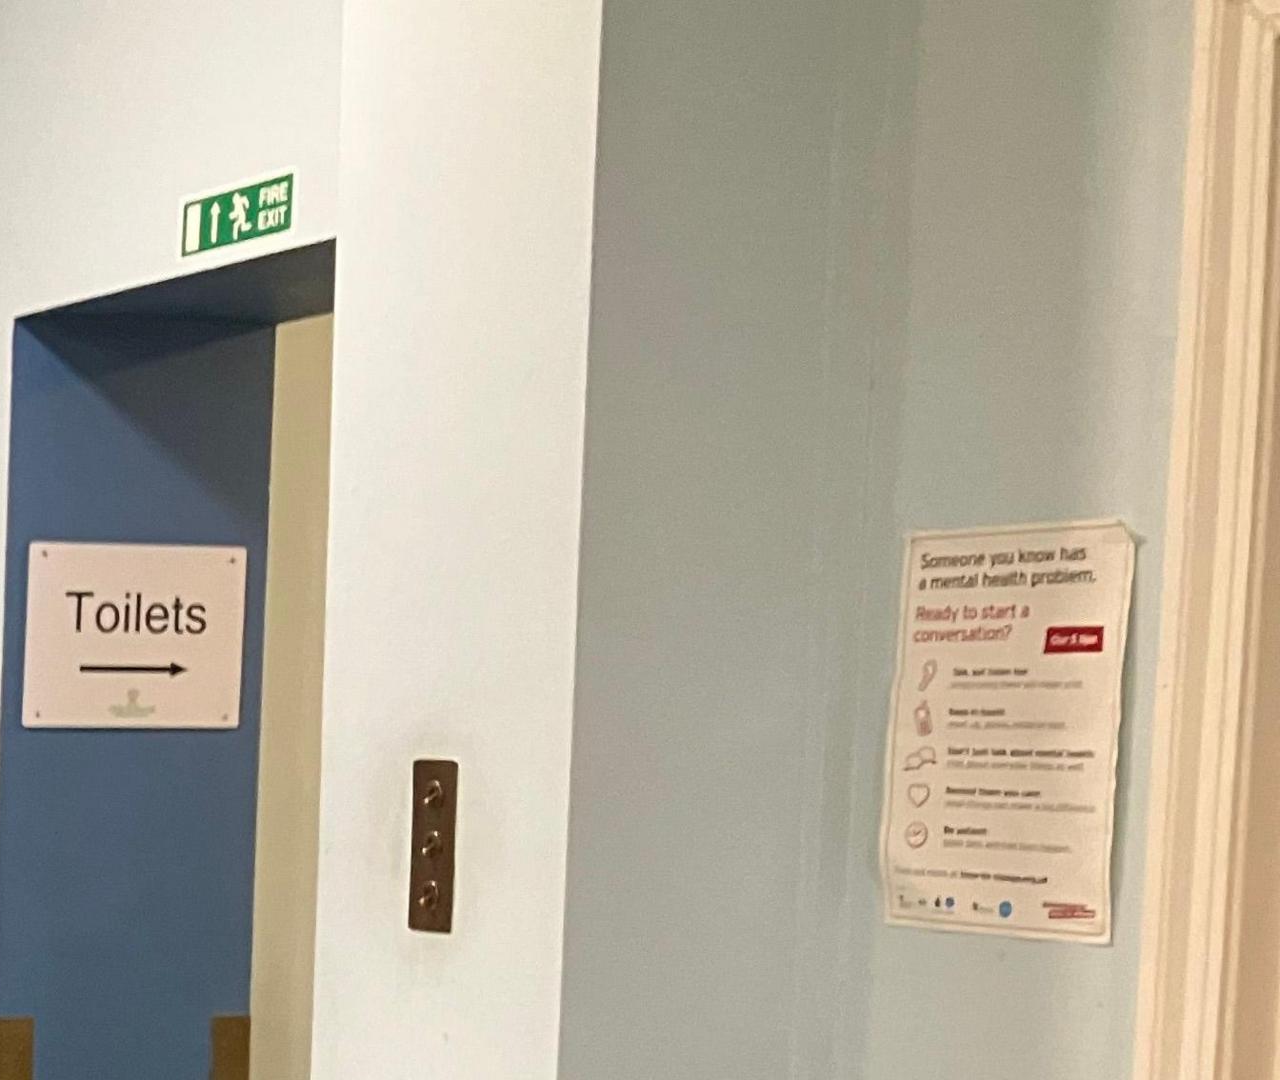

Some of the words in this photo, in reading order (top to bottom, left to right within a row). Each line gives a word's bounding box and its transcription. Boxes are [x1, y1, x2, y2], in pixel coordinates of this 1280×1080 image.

[259, 181, 289, 208] FIRE
[257, 205, 288, 230] EXIT
[920, 552, 986, 570] Someone
[990, 551, 1015, 567] you
[1018, 547, 1055, 563] know
[1060, 547, 1087, 561] has
[918, 577, 927, 590] a
[930, 573, 979, 589] mental
[982, 571, 1028, 587] health
[1031, 570, 1097, 587] problem.
[65, 590, 207, 634] Toilets
[915, 605, 959, 623] Ready
[962, 605, 978, 620] to
[981, 604, 1017, 620] start
[1019, 606, 1030, 619] a
[913, 624, 1013, 642] conversation?
